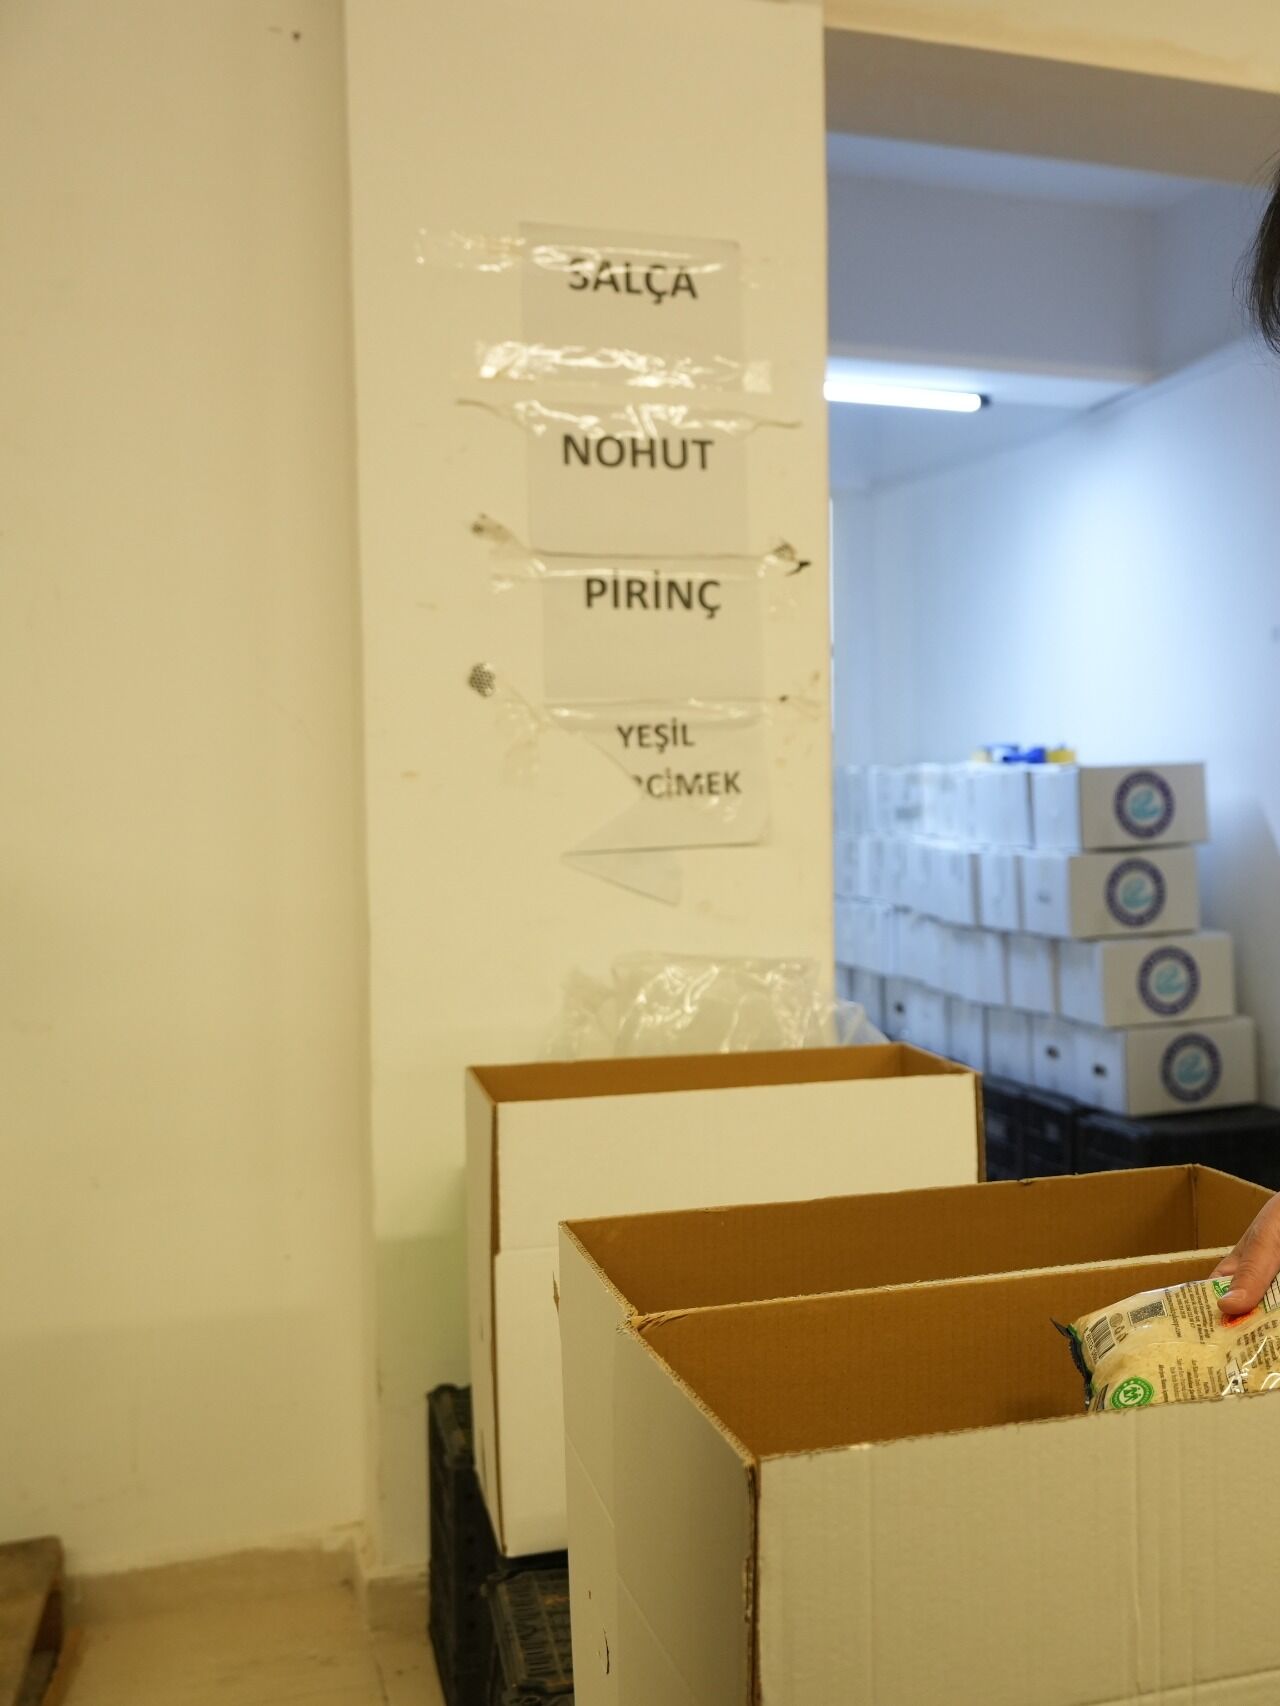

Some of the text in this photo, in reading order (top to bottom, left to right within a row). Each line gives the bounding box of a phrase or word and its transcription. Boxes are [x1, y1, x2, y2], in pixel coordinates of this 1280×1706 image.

[568, 257, 699, 305] SALÇA
[562, 433, 715, 472] NOHUT
[584, 569, 723, 619] PİRİNÇ
[616, 716, 696, 754] YEŞİL
[632, 769, 743, 800] CİMEK
